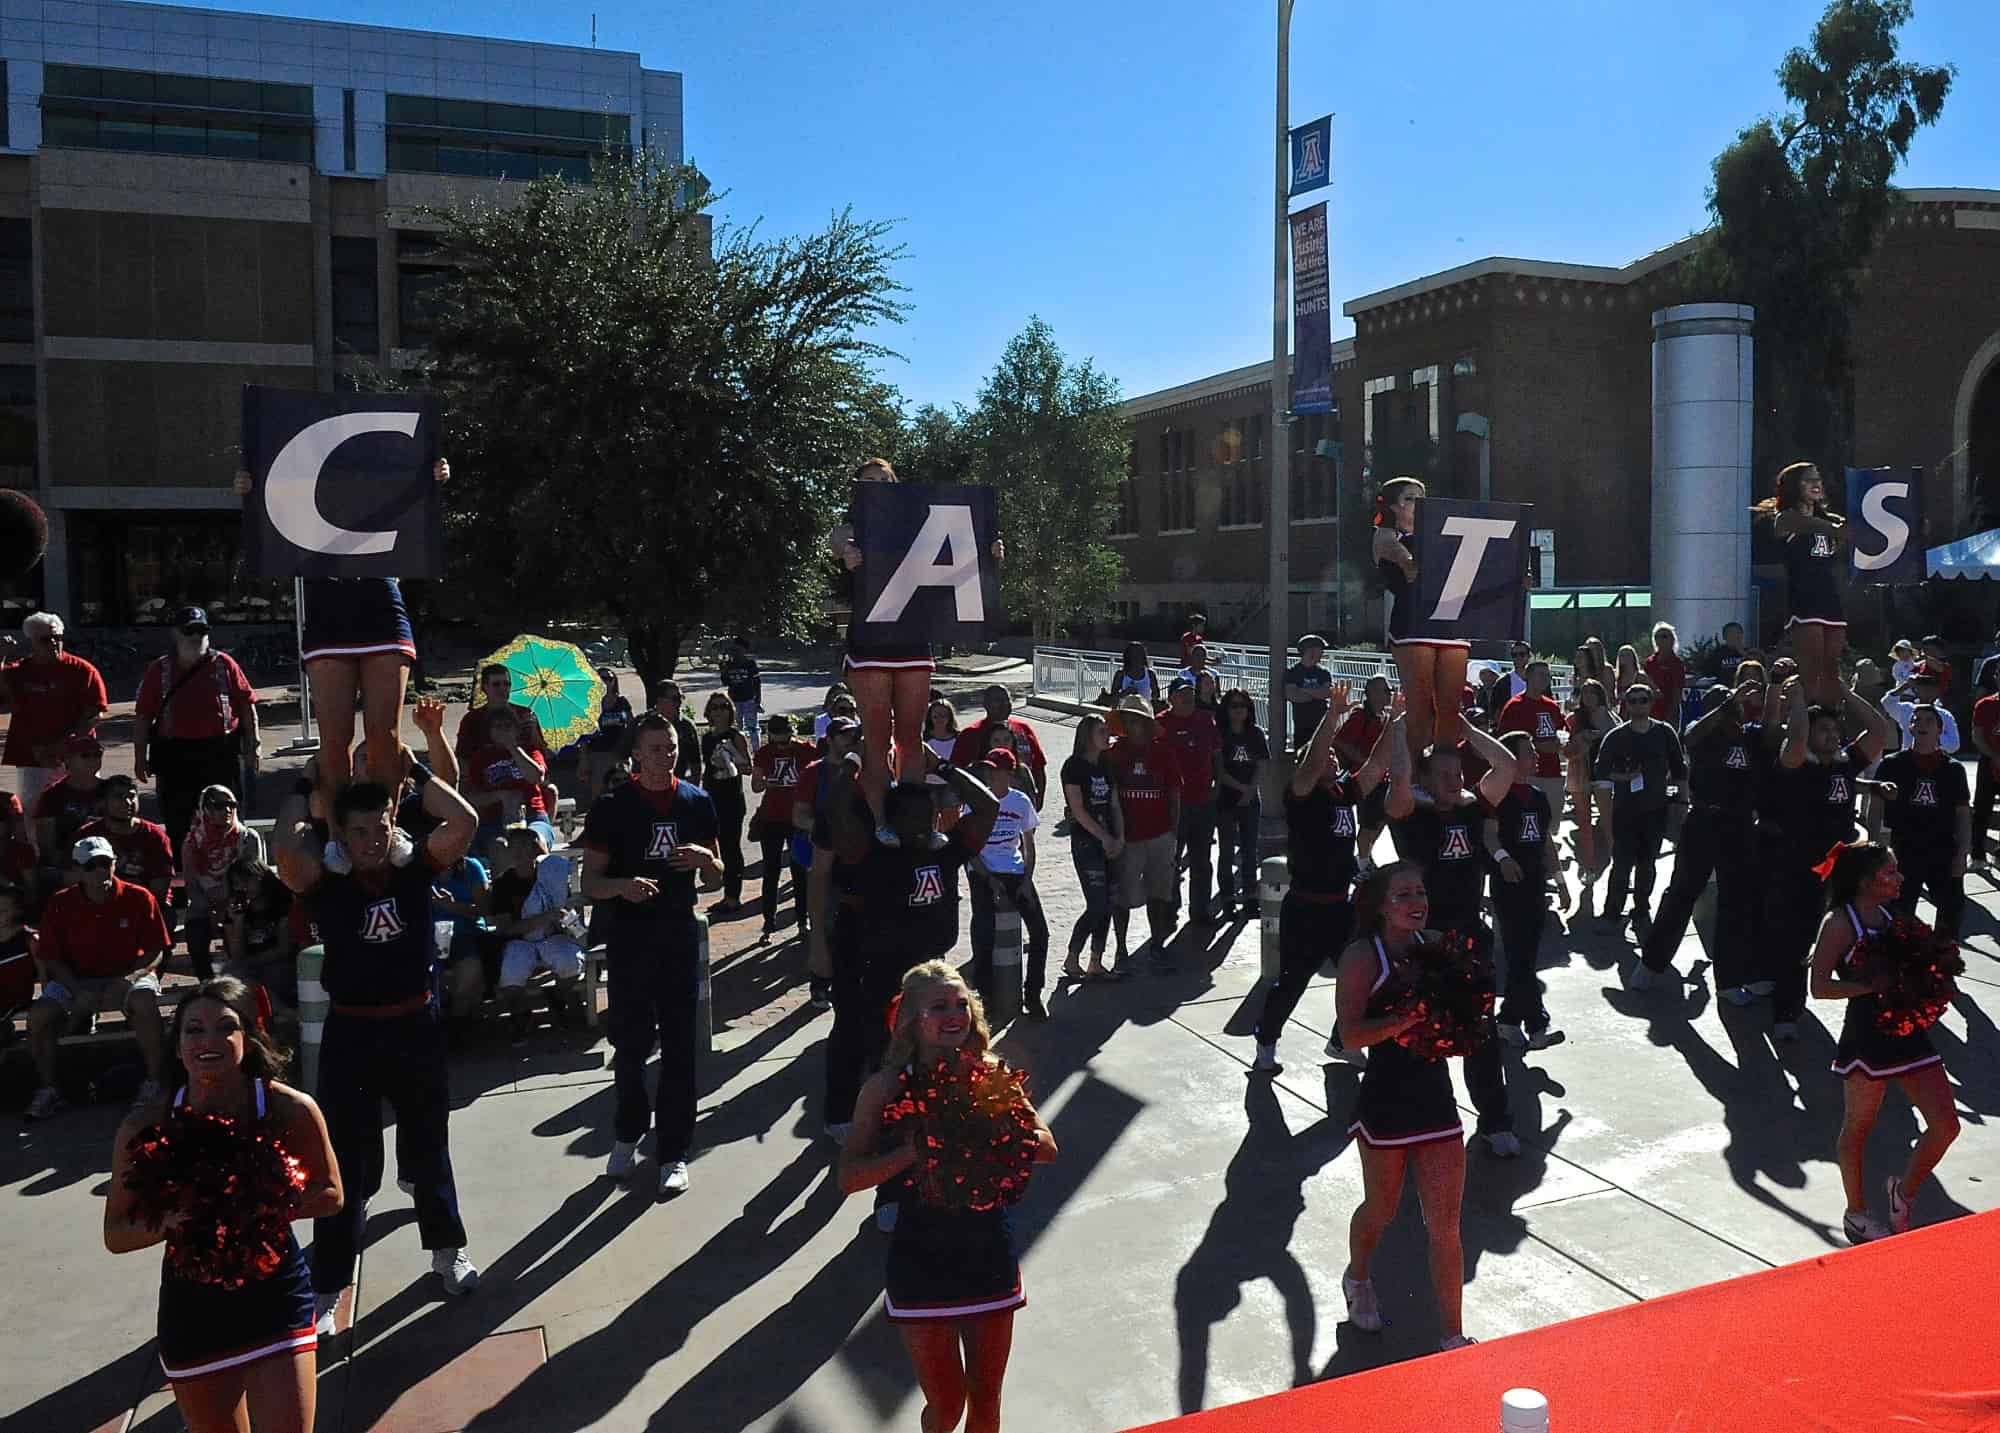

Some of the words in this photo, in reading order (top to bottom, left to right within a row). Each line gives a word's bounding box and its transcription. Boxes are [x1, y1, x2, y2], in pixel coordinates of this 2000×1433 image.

[1295, 131, 1325, 184] A
[1293, 221, 1308, 238] WE
[1308, 215, 1325, 233] ARE
[265, 412, 420, 555] C
[1854, 482, 1910, 570] S
[1808, 532, 1834, 559] A
[866, 505, 985, 622] A
[1429, 516, 1517, 620] T
[1535, 712, 1557, 737] A
[1231, 745, 1251, 761] A
[1726, 745, 1748, 769] A
[767, 756, 801, 787] A
[1827, 774, 1849, 802] A
[1911, 777, 1937, 807] A
[1333, 806, 1354, 839] A
[1519, 810, 1542, 842] A
[644, 822, 678, 859] A
[1439, 824, 1473, 861] A
[908, 865, 943, 907] A
[360, 897, 405, 943] A
